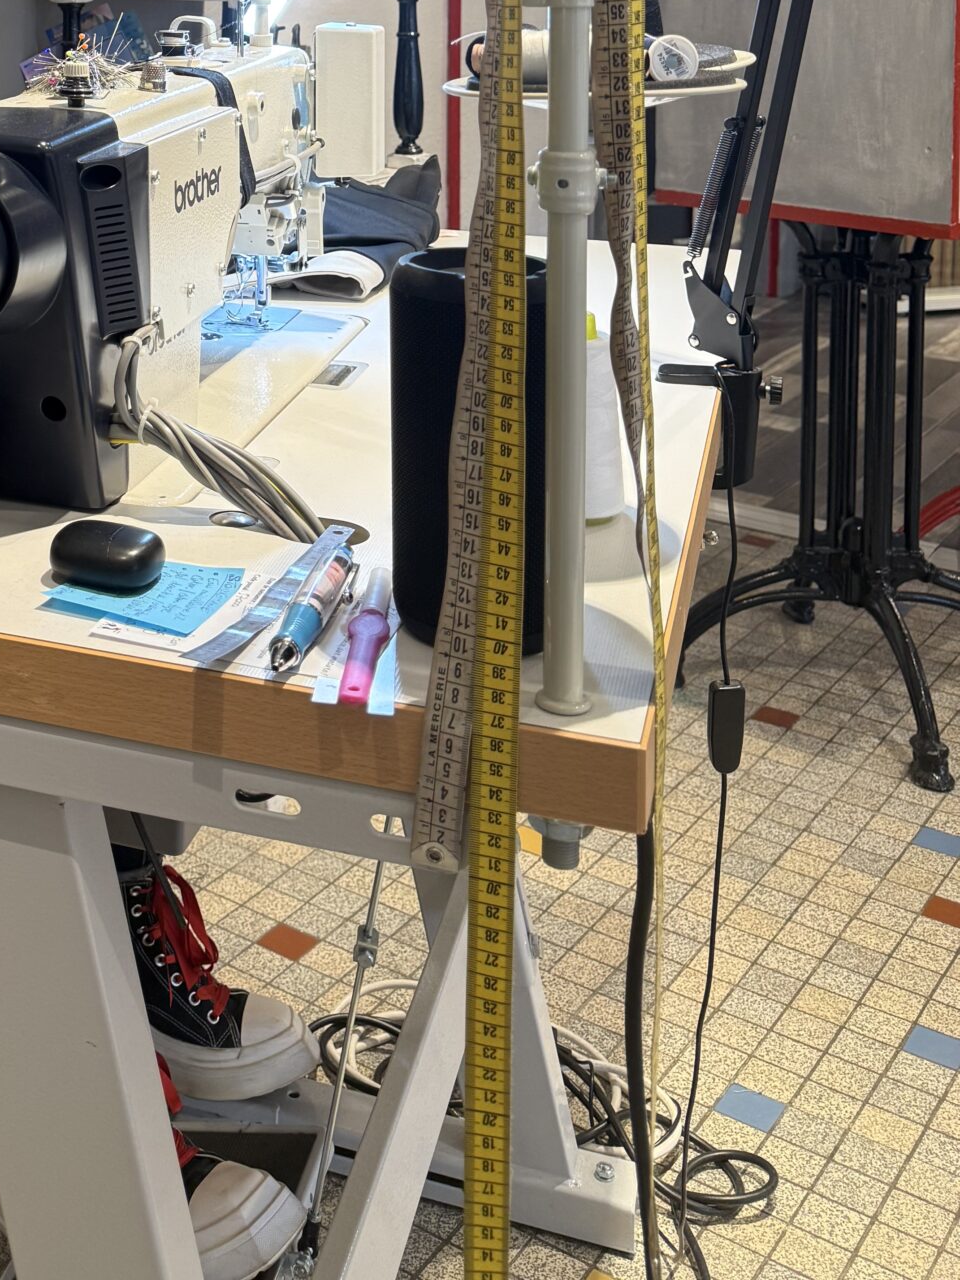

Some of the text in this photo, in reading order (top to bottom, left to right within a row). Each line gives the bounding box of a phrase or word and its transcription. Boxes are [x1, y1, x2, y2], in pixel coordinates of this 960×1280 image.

[611, 5, 625, 20] 35
[612, 28, 626, 44] 34
[612, 52, 628, 68] 33
[613, 76, 629, 91] 32
[616, 100, 630, 116] 31
[616, 123, 630, 139] 30
[617, 147, 631, 162] 29
[619, 170, 631, 186] 28
[175, 165, 222, 214] brother
[620, 193, 631, 209] 27
[505, 225, 515, 238] 57
[503, 248, 514, 263] 56
[503, 273, 514, 287] 55
[503, 298, 514, 311] 54
[502, 322, 513, 336] 53
[501, 346, 512, 360] 52
[501, 370, 512, 385] 51
[473, 392, 487, 409] 20
[500, 395, 512, 409] 50
[472, 416, 485, 433] 19
[500, 419, 512, 434] 49
[471, 440, 484, 457] 18
[500, 444, 512, 458] 48
[469, 464, 483, 481] 17
[499, 468, 511, 483] 47
[468, 489, 481, 506] 16
[498, 493, 511, 508] 46
[466, 513, 479, 531] 15
[498, 517, 511, 532] 45
[461, 537, 476, 555] 14
[497, 542, 510, 556] 44
[460, 562, 473, 579] 13
[496, 567, 510, 581] 43
[458, 586, 471, 604] 12
[495, 592, 509, 606] 42
[456, 611, 470, 629] 11
[495, 617, 508, 631] 41
[453, 635, 468, 654] 10
[494, 641, 508, 656] 40
[453, 663, 462, 678] 9
[492, 666, 506, 681] 39
[451, 687, 459, 703] 8
[492, 690, 505, 704] 38
[428, 666, 446, 767] LA MERCERIE
[448, 713, 455, 729] 7
[491, 715, 505, 729] 37
[445, 738, 453, 753] 6
[490, 739, 504, 753] 36
[442, 763, 451, 778] 5
[489, 763, 503, 777] 35
[440, 786, 449, 800] 4
[489, 788, 502, 802] 34
[437, 808, 447, 823] 3
[487, 811, 502, 825] 33
[487, 835, 502, 849] 32
[488, 858, 501, 872] 31
[486, 882, 501, 896] 30
[486, 906, 500, 919] 29
[485, 930, 499, 943] 28
[484, 953, 498, 967] 27
[484, 977, 498, 991] 26
[483, 1001, 497, 1015] 25
[483, 1024, 497, 1038] 24
[483, 1047, 497, 1060] 23
[483, 1069, 497, 1082] 22
[484, 1091, 497, 1104] 21
[482, 1114, 497, 1127] 20
[482, 1137, 496, 1150] 19
[482, 1160, 495, 1173] 18
[482, 1183, 495, 1196] 17
[482, 1205, 495, 1218] 16
[482, 1228, 495, 1241] 15
[482, 1250, 494, 1262] 14
